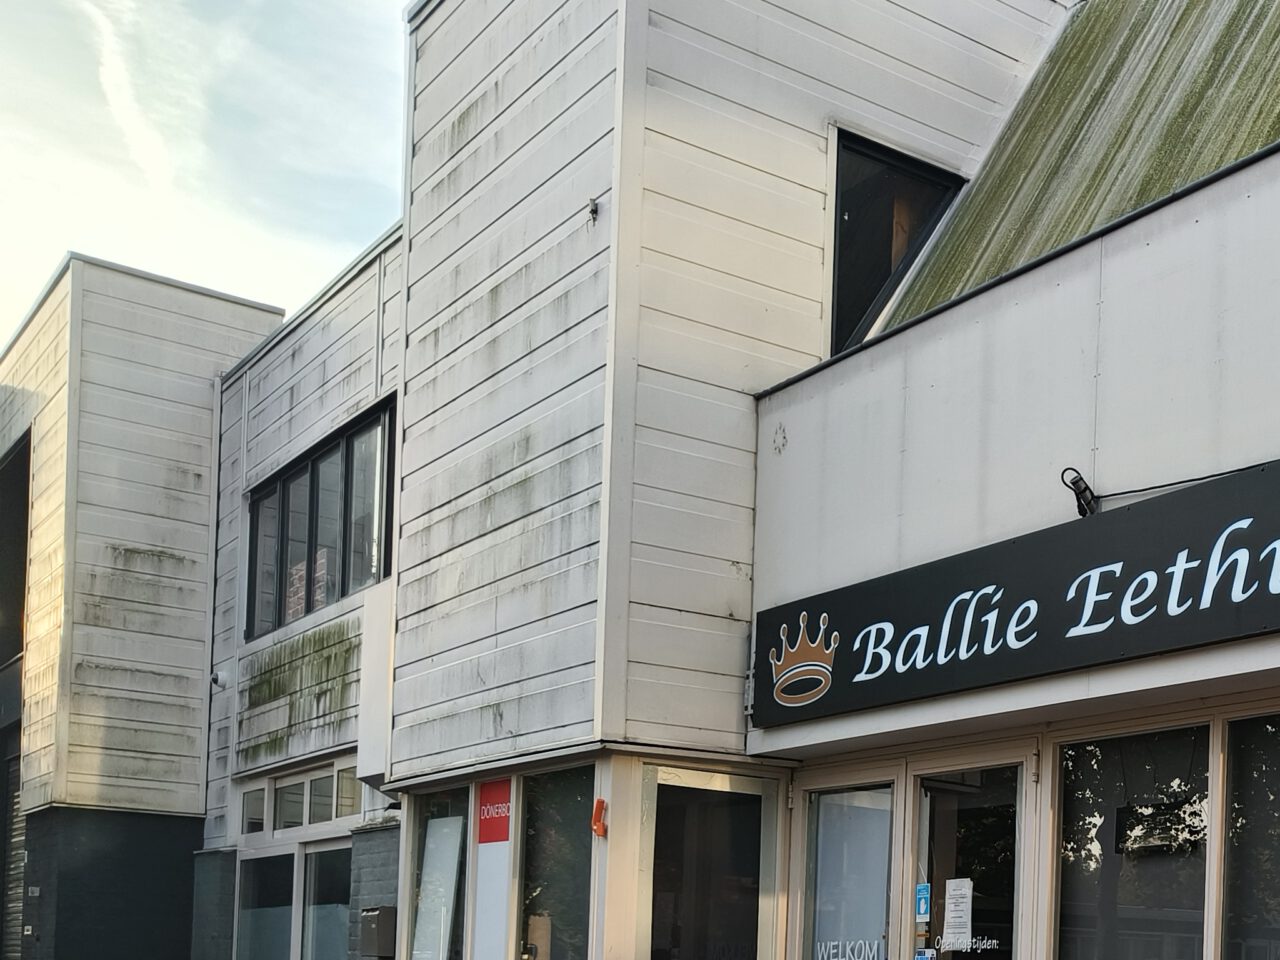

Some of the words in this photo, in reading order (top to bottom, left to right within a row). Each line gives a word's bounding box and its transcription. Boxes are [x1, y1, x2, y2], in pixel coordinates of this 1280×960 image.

[853, 584, 1038, 683] Ballie
[480, 802, 511, 820] DÖNERBO
[934, 935, 1000, 954] Openingstijden:
